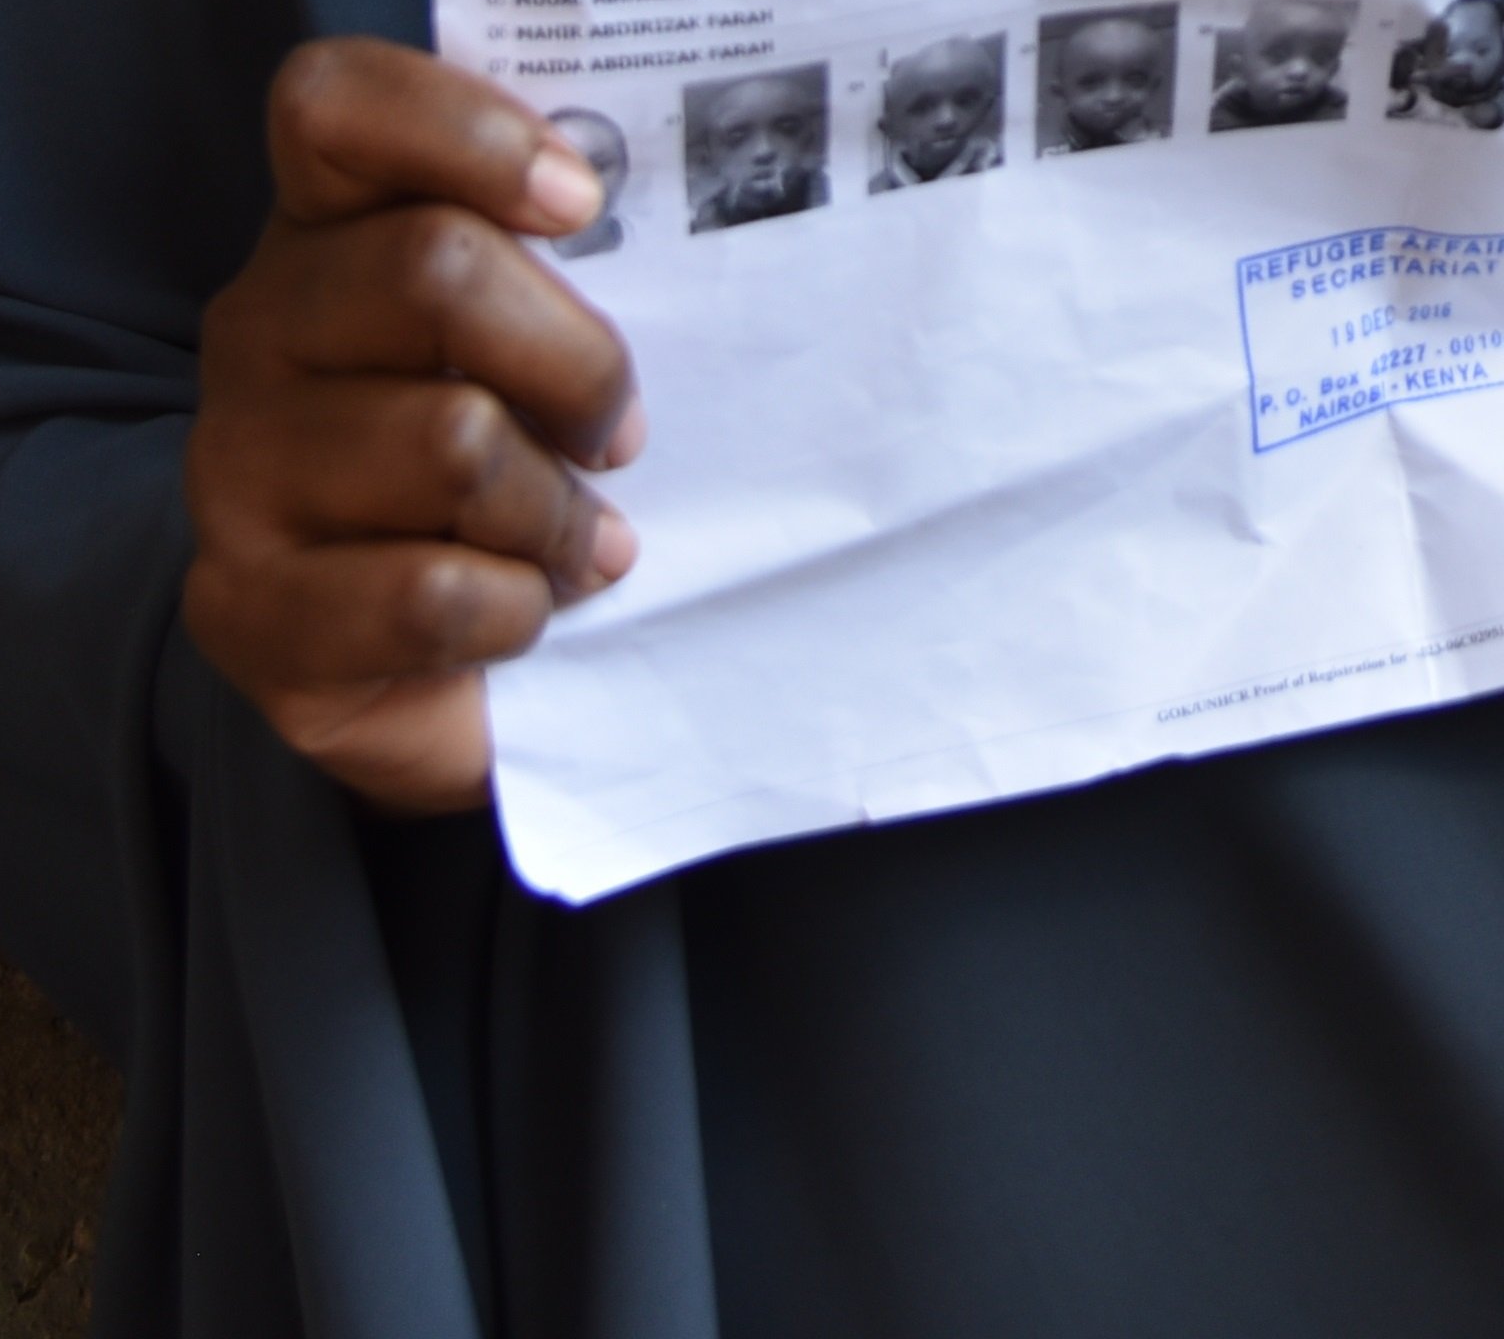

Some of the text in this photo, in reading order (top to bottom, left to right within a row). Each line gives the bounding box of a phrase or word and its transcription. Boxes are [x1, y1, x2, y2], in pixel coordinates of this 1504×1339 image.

[515, 20, 585, 43] MAHIR
[587, 12, 701, 40] ABDIRIZAK
[706, 7, 775, 29] FARAH
[517, 55, 586, 77] MAIDA
[590, 46, 703, 73] ABDIRIZAK
[708, 38, 776, 63] FARAH
[1245, 233, 1387, 285] REFUGEE
[1290, 254, 1501, 299] SECRETARIAT
[1360, 303, 1396, 338] DEC
[1408, 301, 1453, 323] 2016
[1258, 394, 1279, 416] P.
[1285, 387, 1308, 407] O.
[1319, 372, 1360, 395] Box
[1298, 379, 1387, 429] NAIROBI
[1405, 362, 1490, 392] KENYA
[1156, 687, 1251, 724] GOK/UNHCR
[1253, 676, 1290, 699] Proof
[1292, 671, 1306, 689] of
[1309, 654, 1387, 687] Registration
[1389, 650, 1409, 666] for
